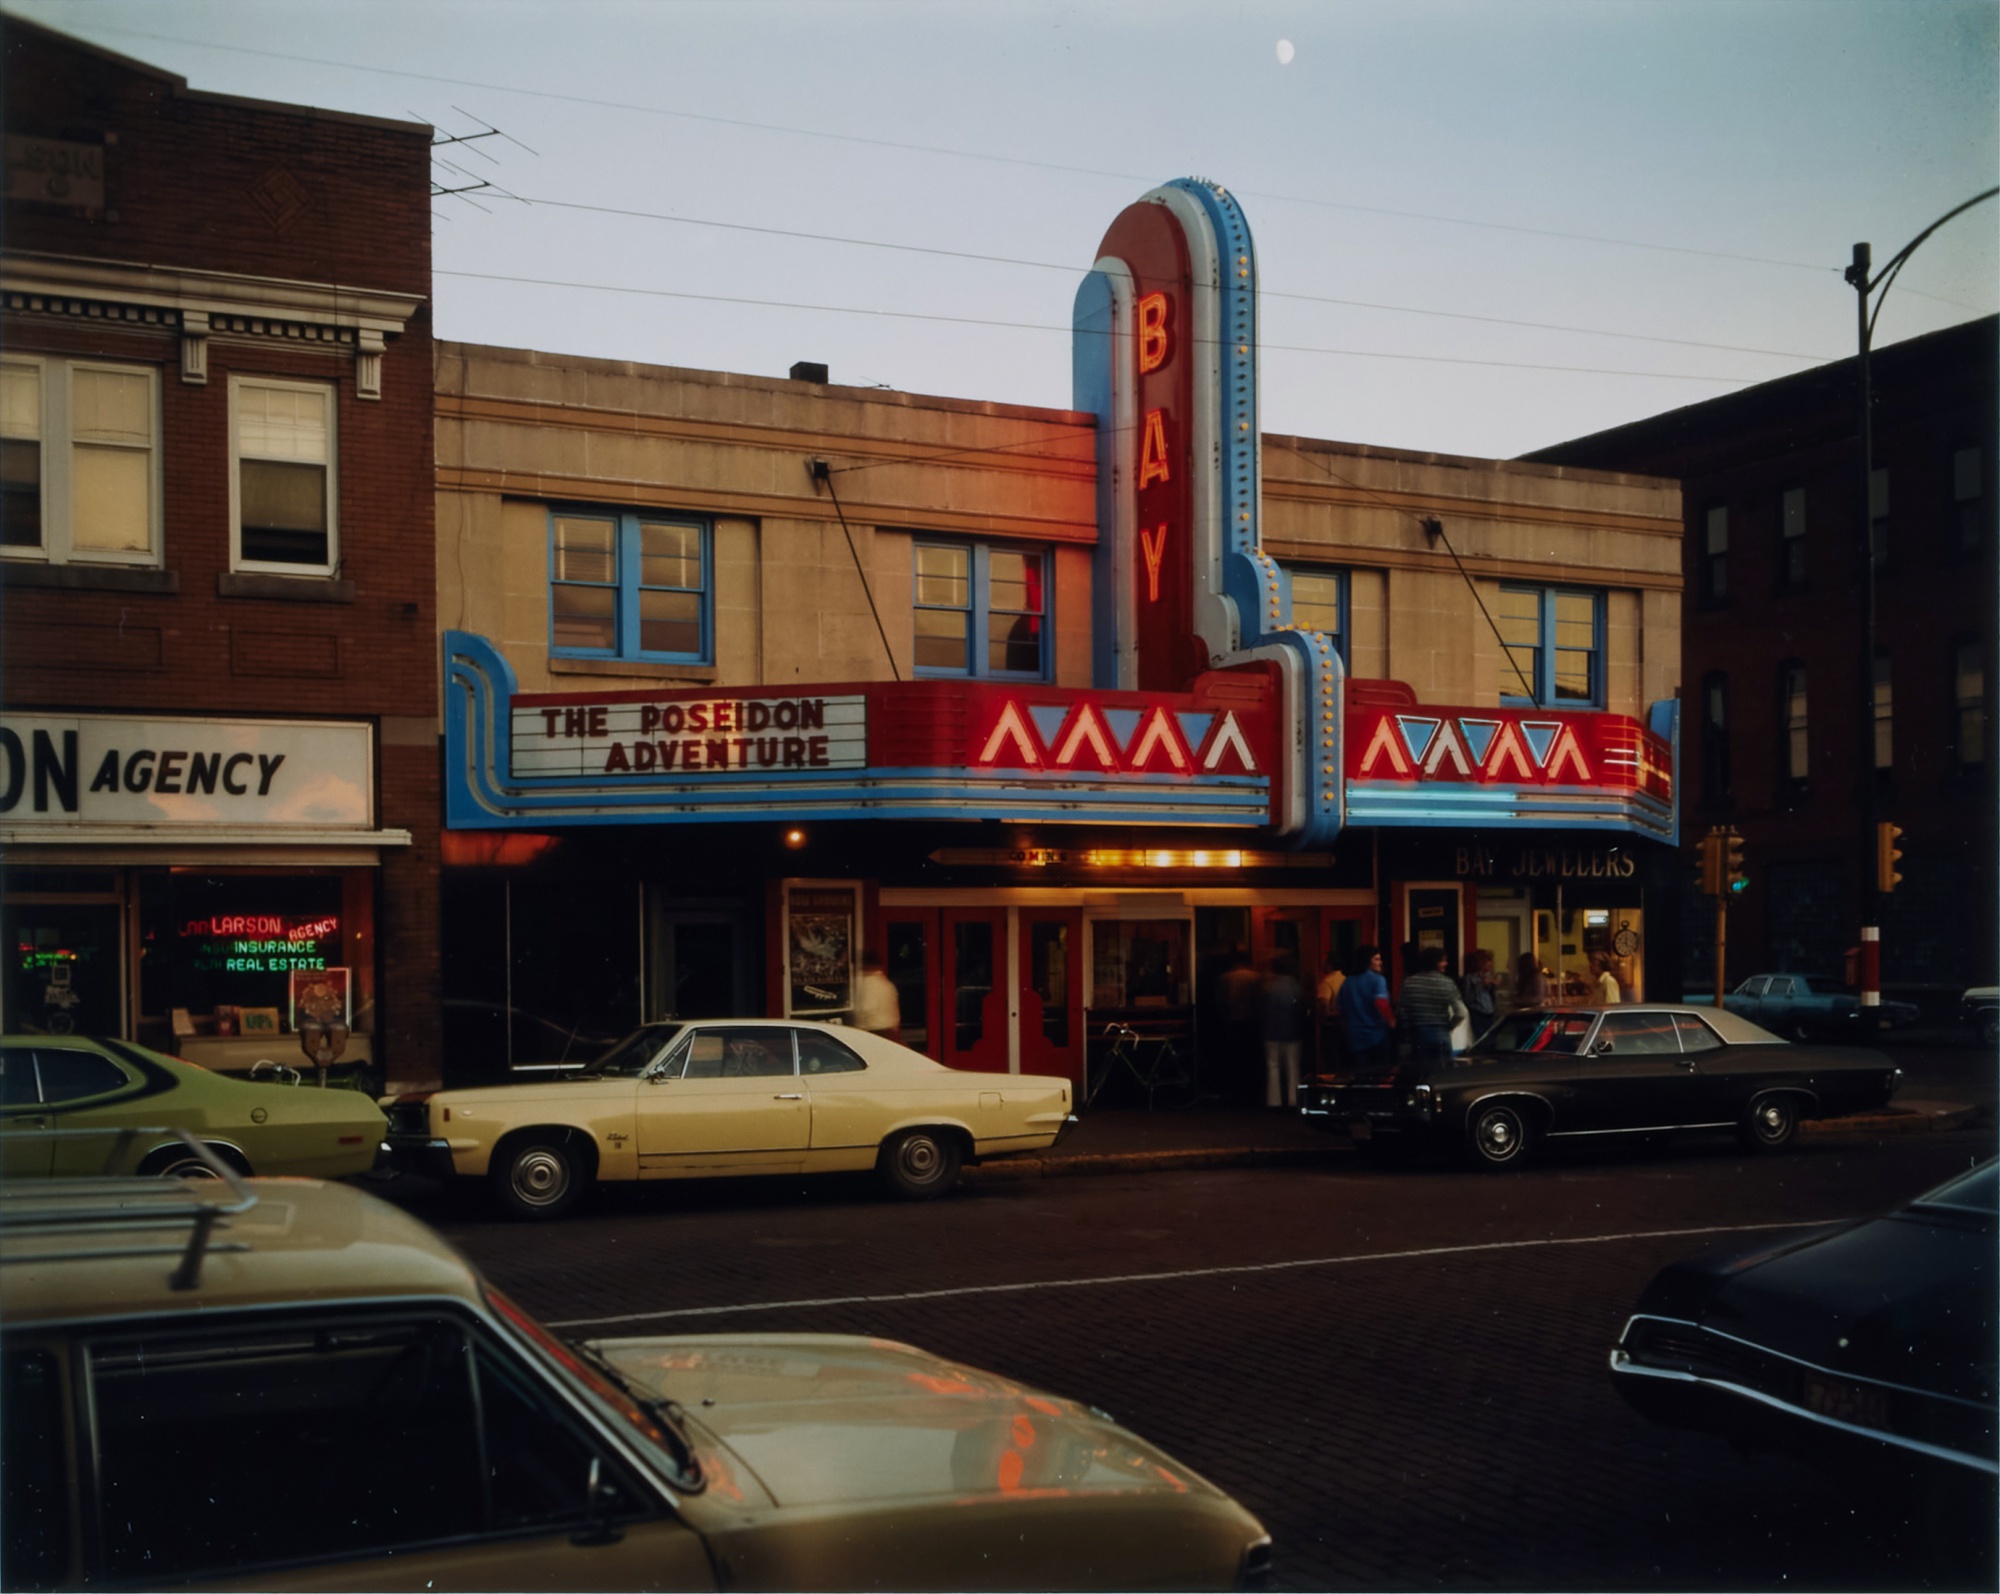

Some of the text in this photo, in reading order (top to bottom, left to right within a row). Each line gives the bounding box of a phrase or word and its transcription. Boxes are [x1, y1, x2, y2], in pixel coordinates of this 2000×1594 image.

[1138, 291, 1170, 602] BAY
[541, 699, 825, 739] THE POSEIDON
[604, 735, 830, 772] ADVENTURE
[90, 749, 286, 796] AGENCY
[1455, 847, 1636, 878] BAY JEWELERS
[211, 916, 282, 935] LARSON
[288, 917, 338, 941] AGENCY
[234, 940, 317, 954] INSURANCE
[226, 957, 265, 972] REAL
[268, 957, 326, 972] ESTATE
